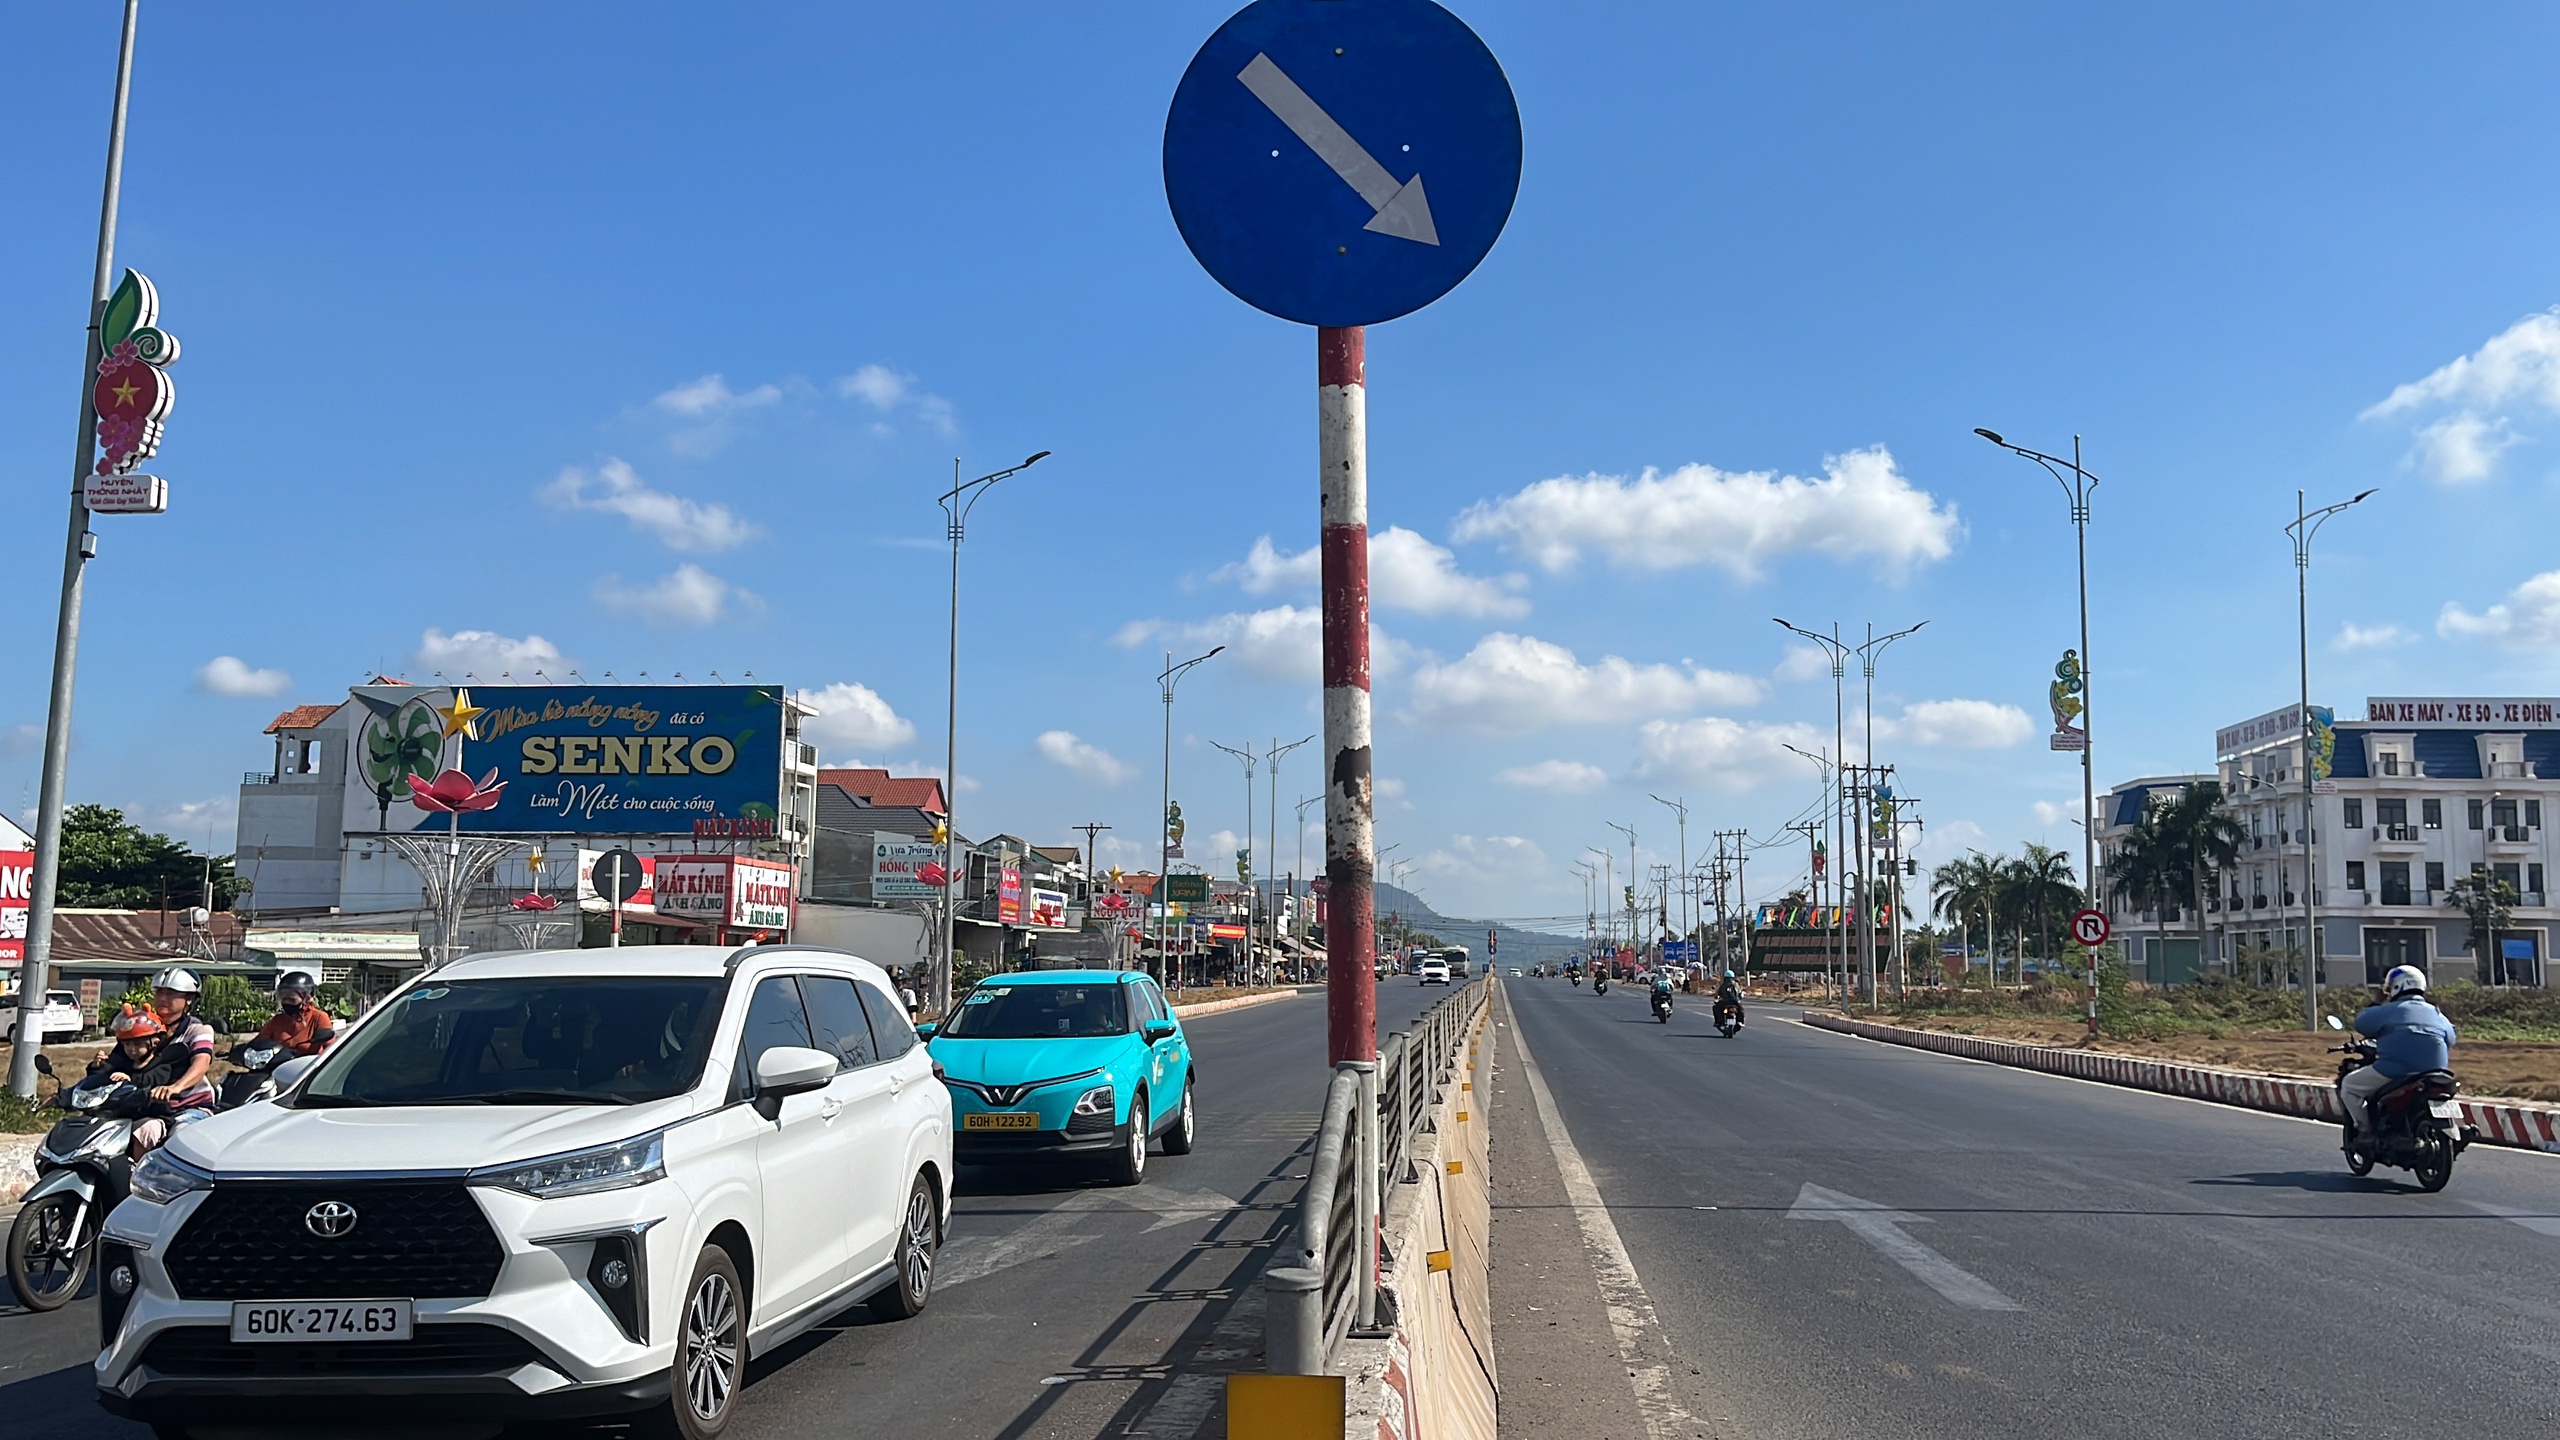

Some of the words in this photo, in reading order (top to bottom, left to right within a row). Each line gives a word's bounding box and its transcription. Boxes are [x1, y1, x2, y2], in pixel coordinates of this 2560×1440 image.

[478, 705, 539, 743] Mùa
[541, 698, 565, 722] hè
[565, 695, 613, 728] nắng
[613, 701, 660, 732] nóng
[669, 712, 688, 725] đã
[689, 711, 705, 725] có
[2399, 703, 2414, 722] XE
[2456, 703, 2472, 722] XE
[2476, 703, 2491, 723] 50
[2503, 703, 2519, 723] XE
[521, 735, 736, 775] SENKO
[530, 793, 559, 808] Làm
[557, 779, 620, 820] Mát
[623, 796, 647, 810] cho
[650, 796, 681, 813] cuộc
[683, 794, 715, 813] sống
[658, 864, 686, 894] MẮT
[687, 867, 725, 894] KÍNH
[663, 895, 689, 910] ÁNH
[690, 894, 723, 911] SÁNG
[248, 1307, 397, 1334] 60K-274.63
